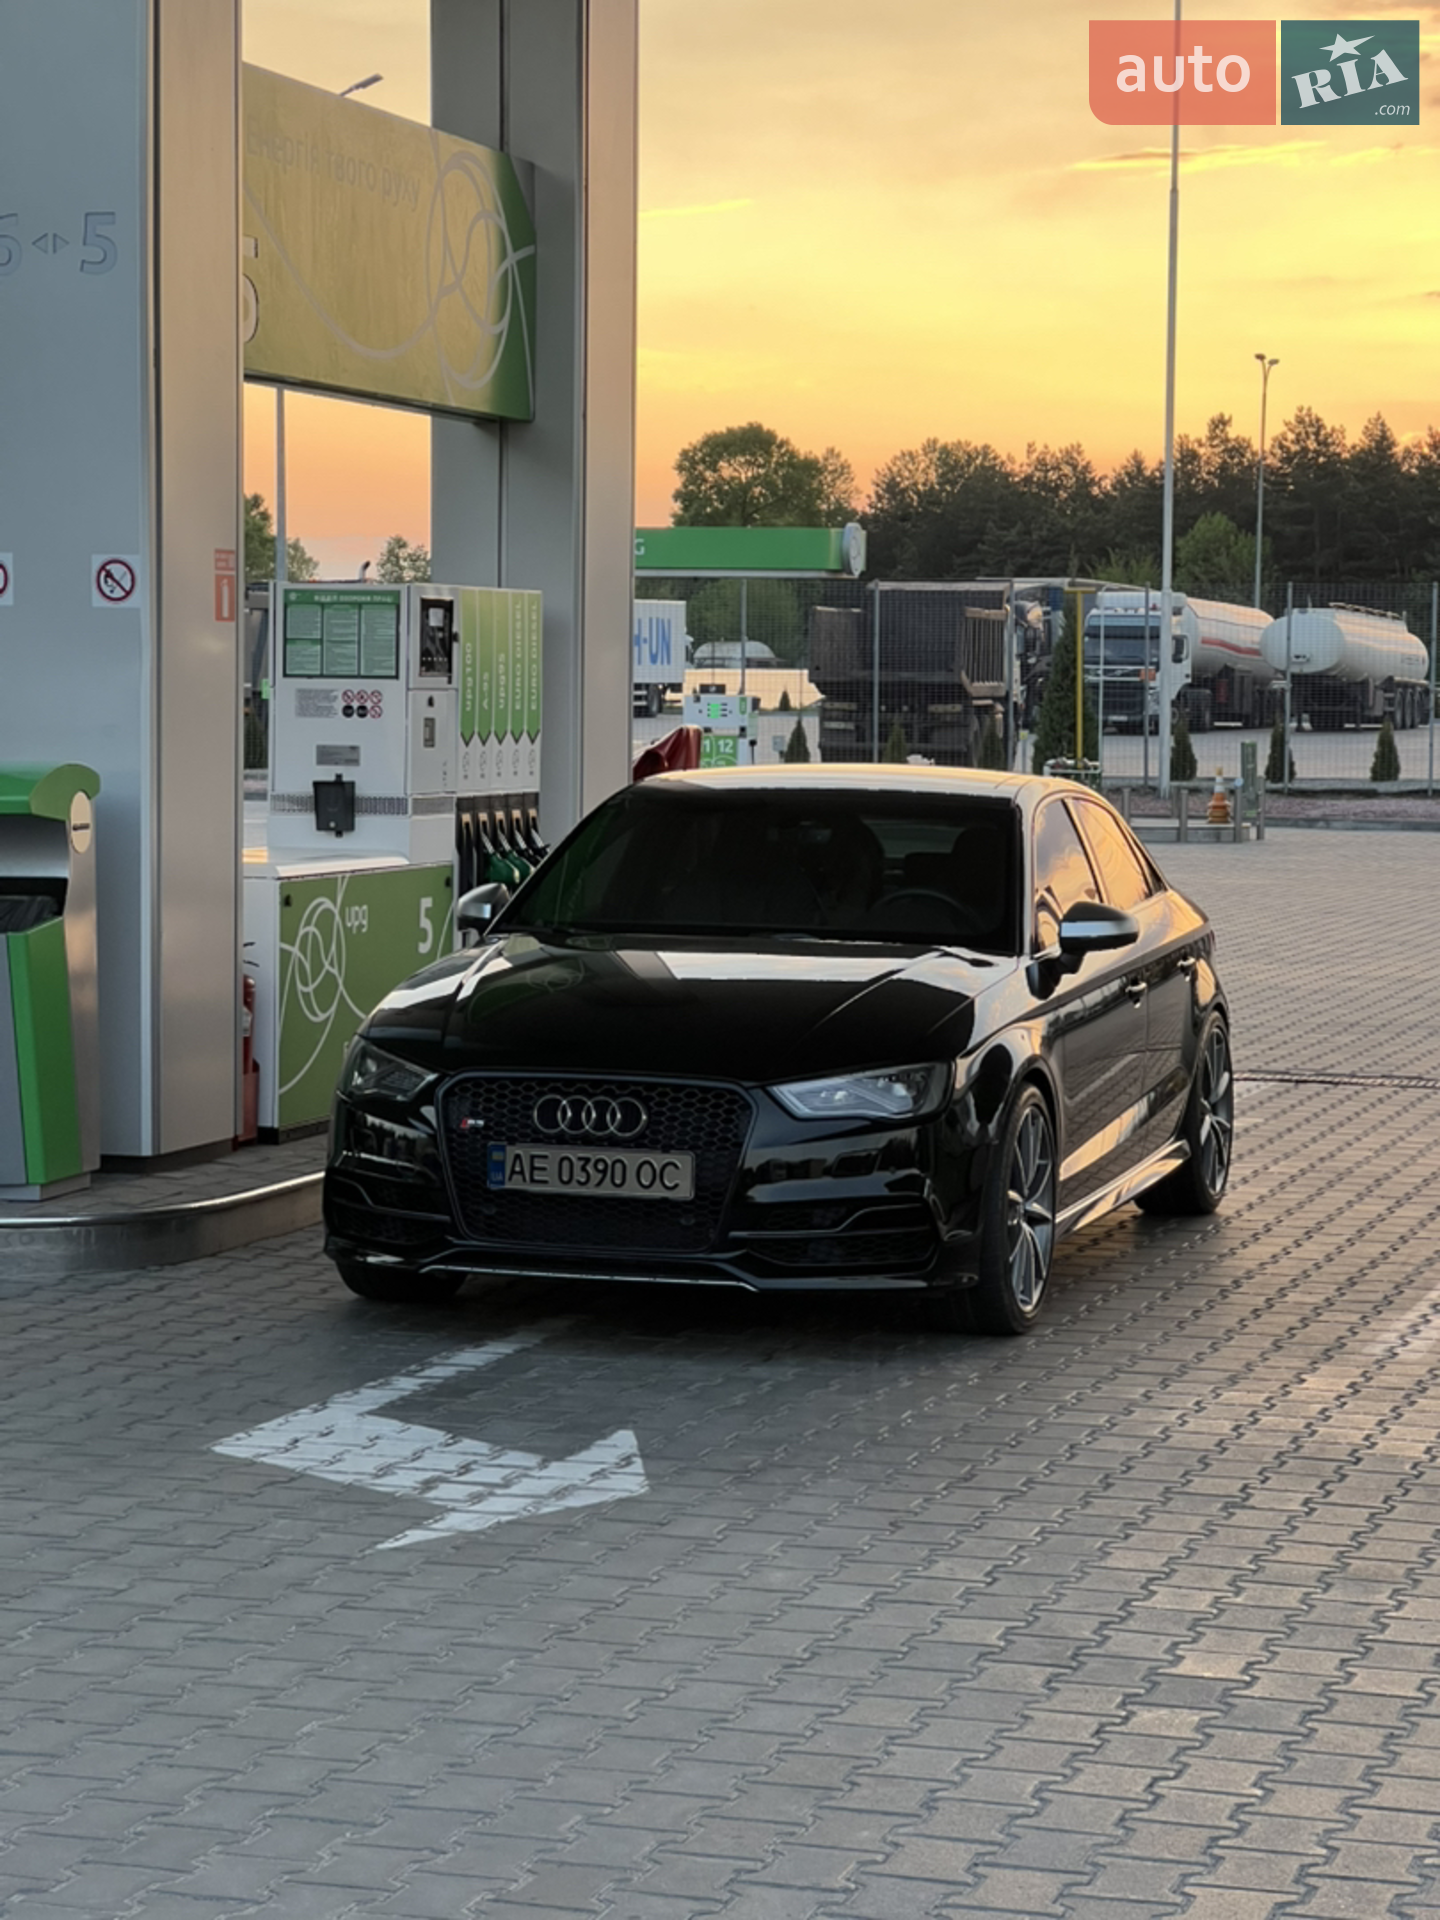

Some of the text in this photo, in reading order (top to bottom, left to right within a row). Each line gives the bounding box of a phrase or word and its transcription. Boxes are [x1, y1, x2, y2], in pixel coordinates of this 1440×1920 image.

[325, 149, 377, 192] твого
[381, 167, 421, 212] руху
[79, 211, 118, 275] 5
[514, 600, 522, 711] EURO DIESEL
[530, 601, 538, 711] EURO DIESEL
[717, 739, 734, 754] 12
[345, 903, 368, 935] upg
[417, 896, 433, 954] 5
[507, 1152, 680, 1191] AE 0390 OC
